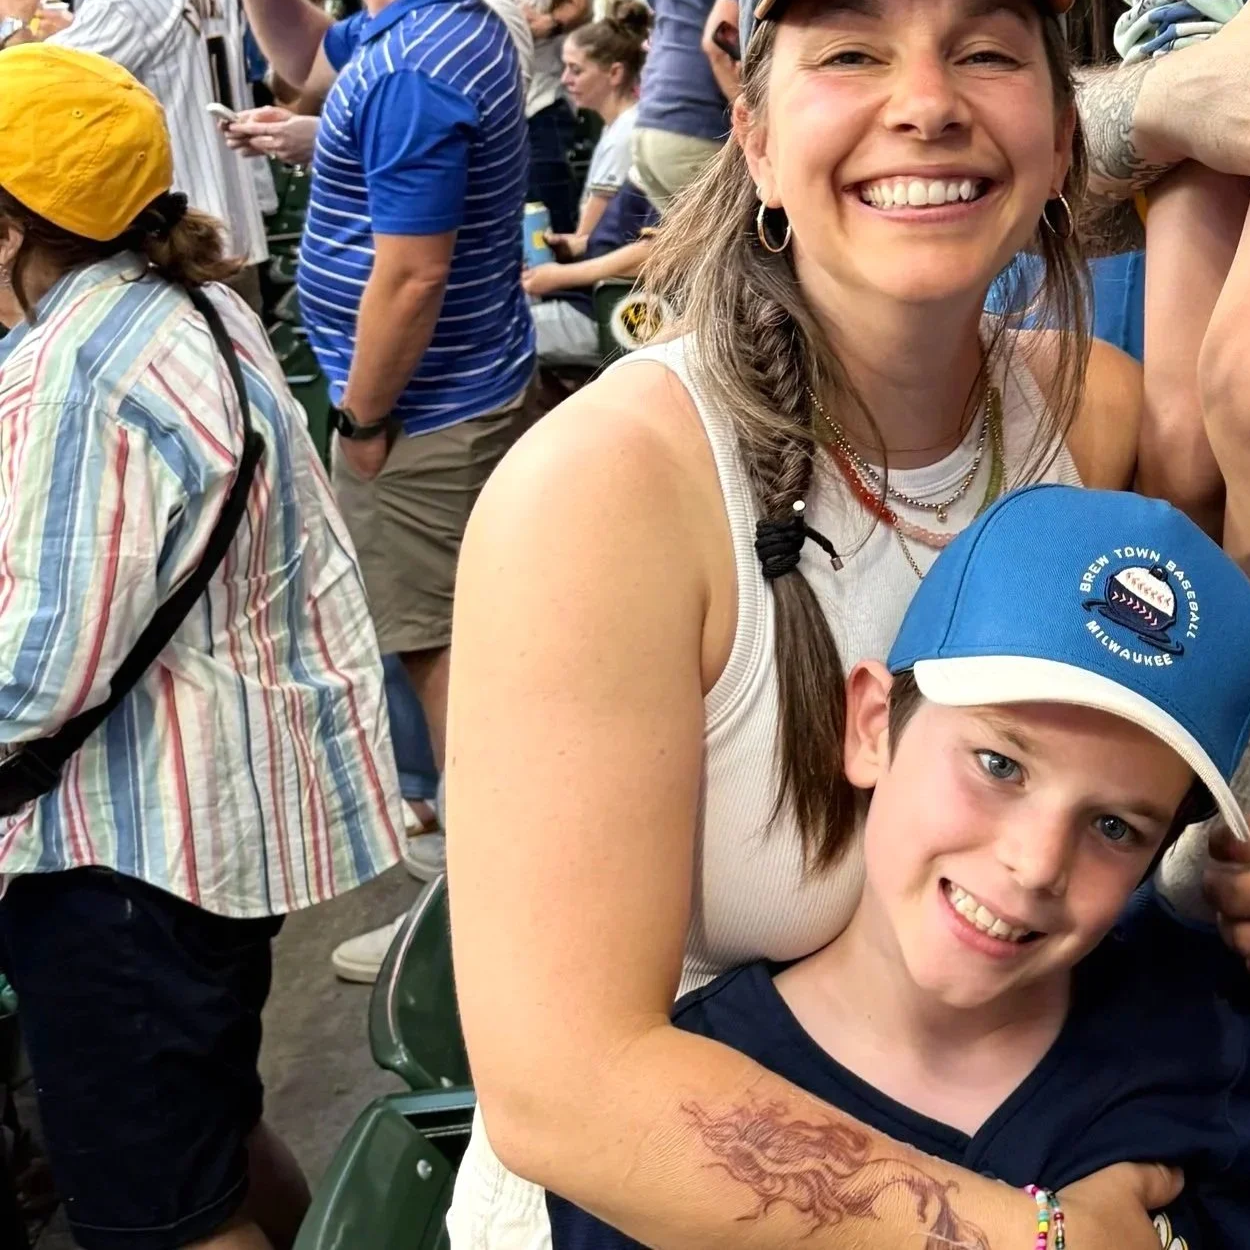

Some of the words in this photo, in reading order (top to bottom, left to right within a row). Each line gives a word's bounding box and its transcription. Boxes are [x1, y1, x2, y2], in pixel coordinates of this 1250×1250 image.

[1080, 555, 1109, 592] BREW
[1113, 546, 1161, 562] TOWN
[1165, 560, 1200, 638] BASEBALL
[1086, 620, 1173, 667] MILWAUKEE
